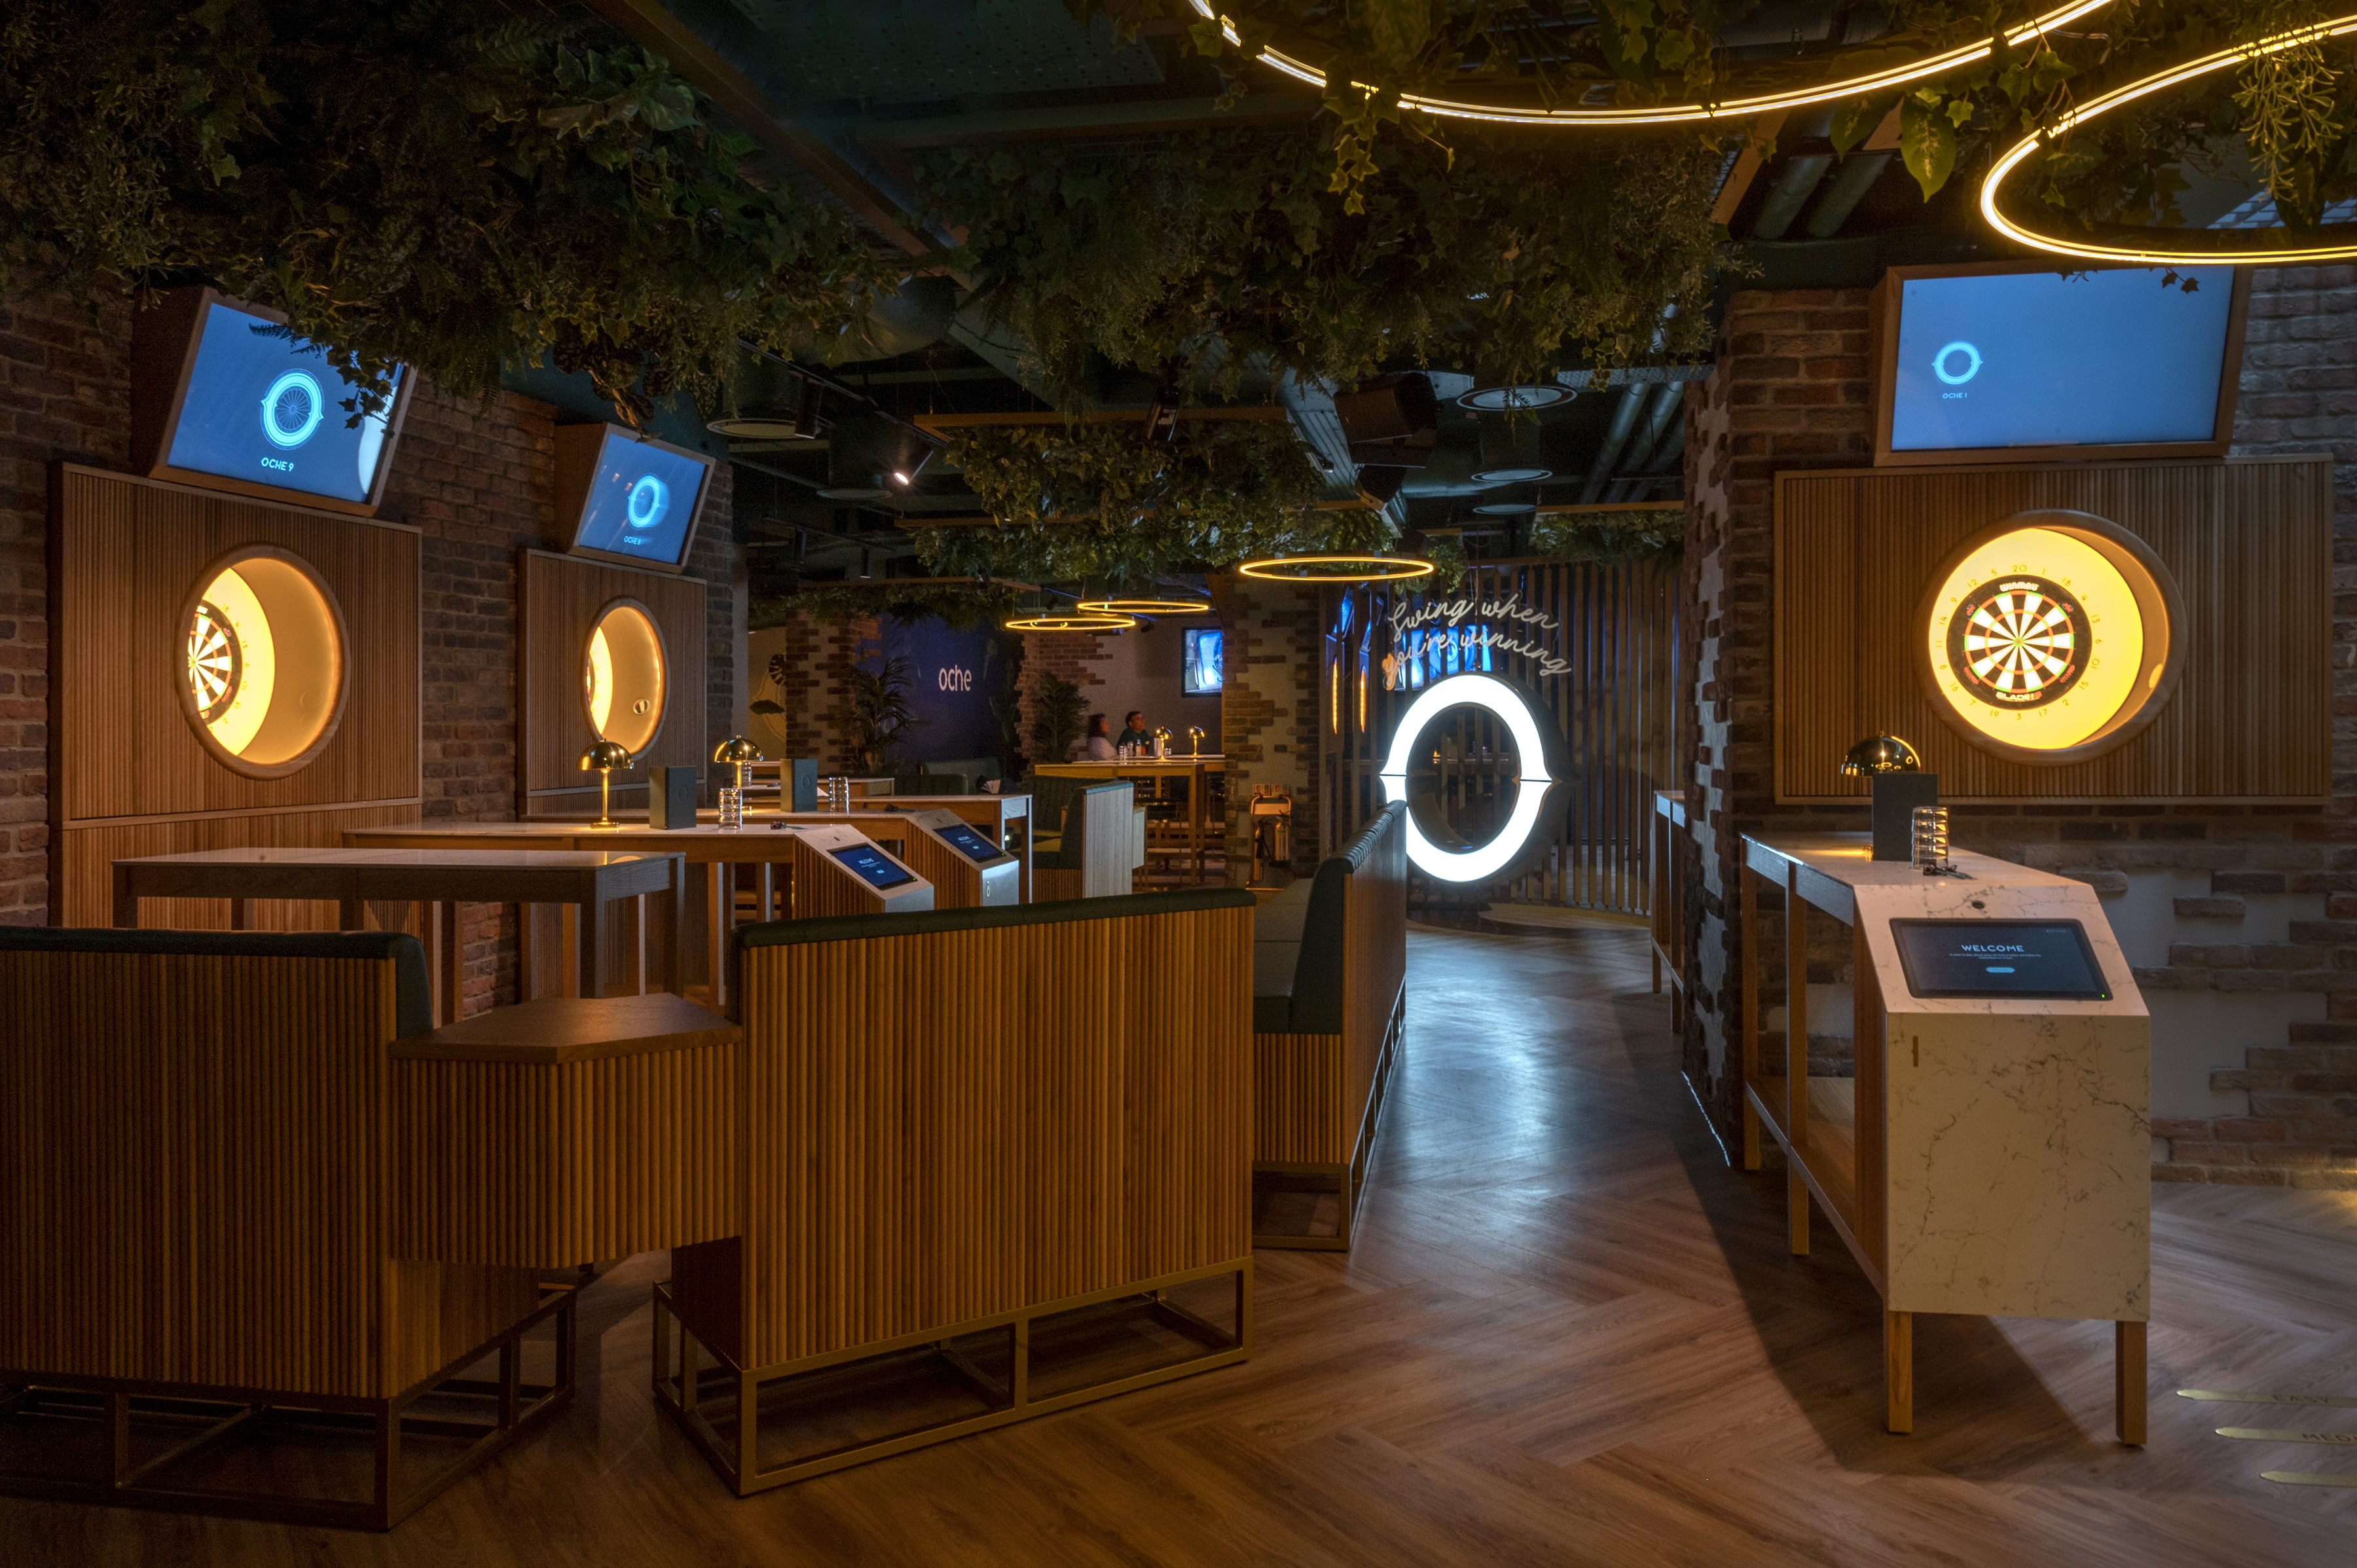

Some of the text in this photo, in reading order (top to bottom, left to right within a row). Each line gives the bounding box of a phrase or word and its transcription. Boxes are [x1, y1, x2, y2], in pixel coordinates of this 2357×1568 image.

[261, 457, 294, 472] OCHE 9
[1967, 579, 1978, 588] 12
[2062, 577, 2072, 587] 18
[1387, 593, 1559, 643] Swing when
[1939, 616, 1948, 625] 14
[2091, 614, 2100, 624] 13
[1383, 632, 1572, 687] you're winning
[939, 665, 972, 692] oche
[241, 680, 248, 691] 10
[1950, 682, 1959, 692] 16
[2079, 680, 2089, 690] 15
[234, 701, 241, 710] 15
[1989, 709, 2000, 718] 19
[2038, 708, 2047, 718] 17
[2273, 1395, 2328, 1403] EASY
